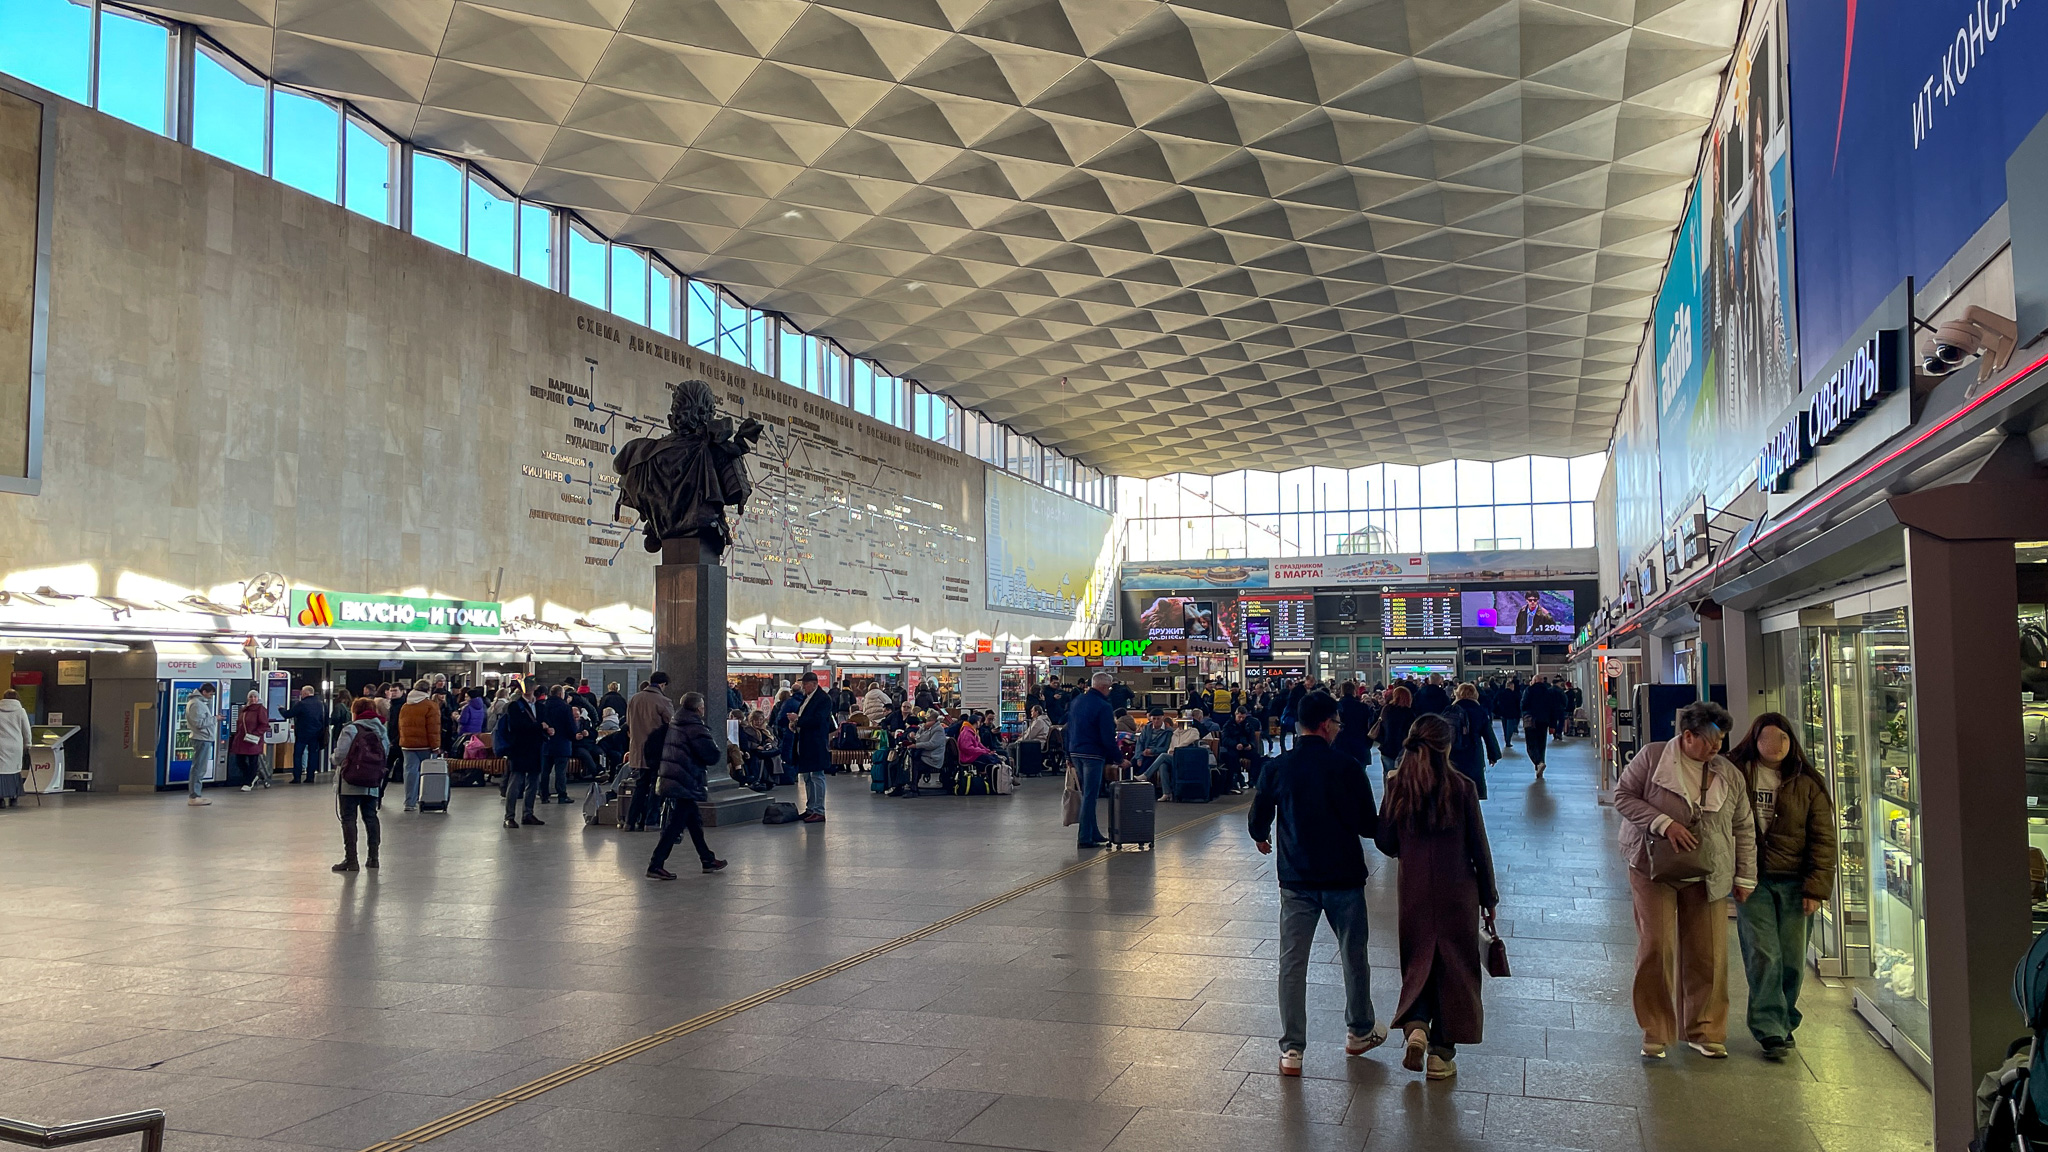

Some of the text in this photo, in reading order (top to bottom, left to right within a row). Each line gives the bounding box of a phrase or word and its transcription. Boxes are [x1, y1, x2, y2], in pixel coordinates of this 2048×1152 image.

[1912, 0, 2021, 150] ИТ-КОНС
[577, 315, 620, 344] СХЕМА
[629, 335, 692, 370] ДВИЖЕНИЯ
[700, 361, 746, 390] ПОЕЗДОВ
[752, 382, 798, 409] ДАЛЬНЕГО
[530, 385, 565, 405] БЕРЛИН
[548, 377, 590, 400] ВАРШАВА
[1757, 411, 1800, 495] ПОДАРКИ
[1809, 330, 1879, 448] СУВЕНИРЫ
[574, 417, 599, 434] ПРАГА
[566, 433, 609, 455] БУДАПЕШТ
[561, 493, 586, 505] ОДЕССА
[529, 509, 586, 526] ДНЕПРОПЕТРОВСК
[585, 556, 608, 567] ХЕРСОН
[1274, 571, 1281, 579] 8
[447, 608, 499, 627] ТОЧКА
[1063, 639, 1152, 657] SUBWAY
